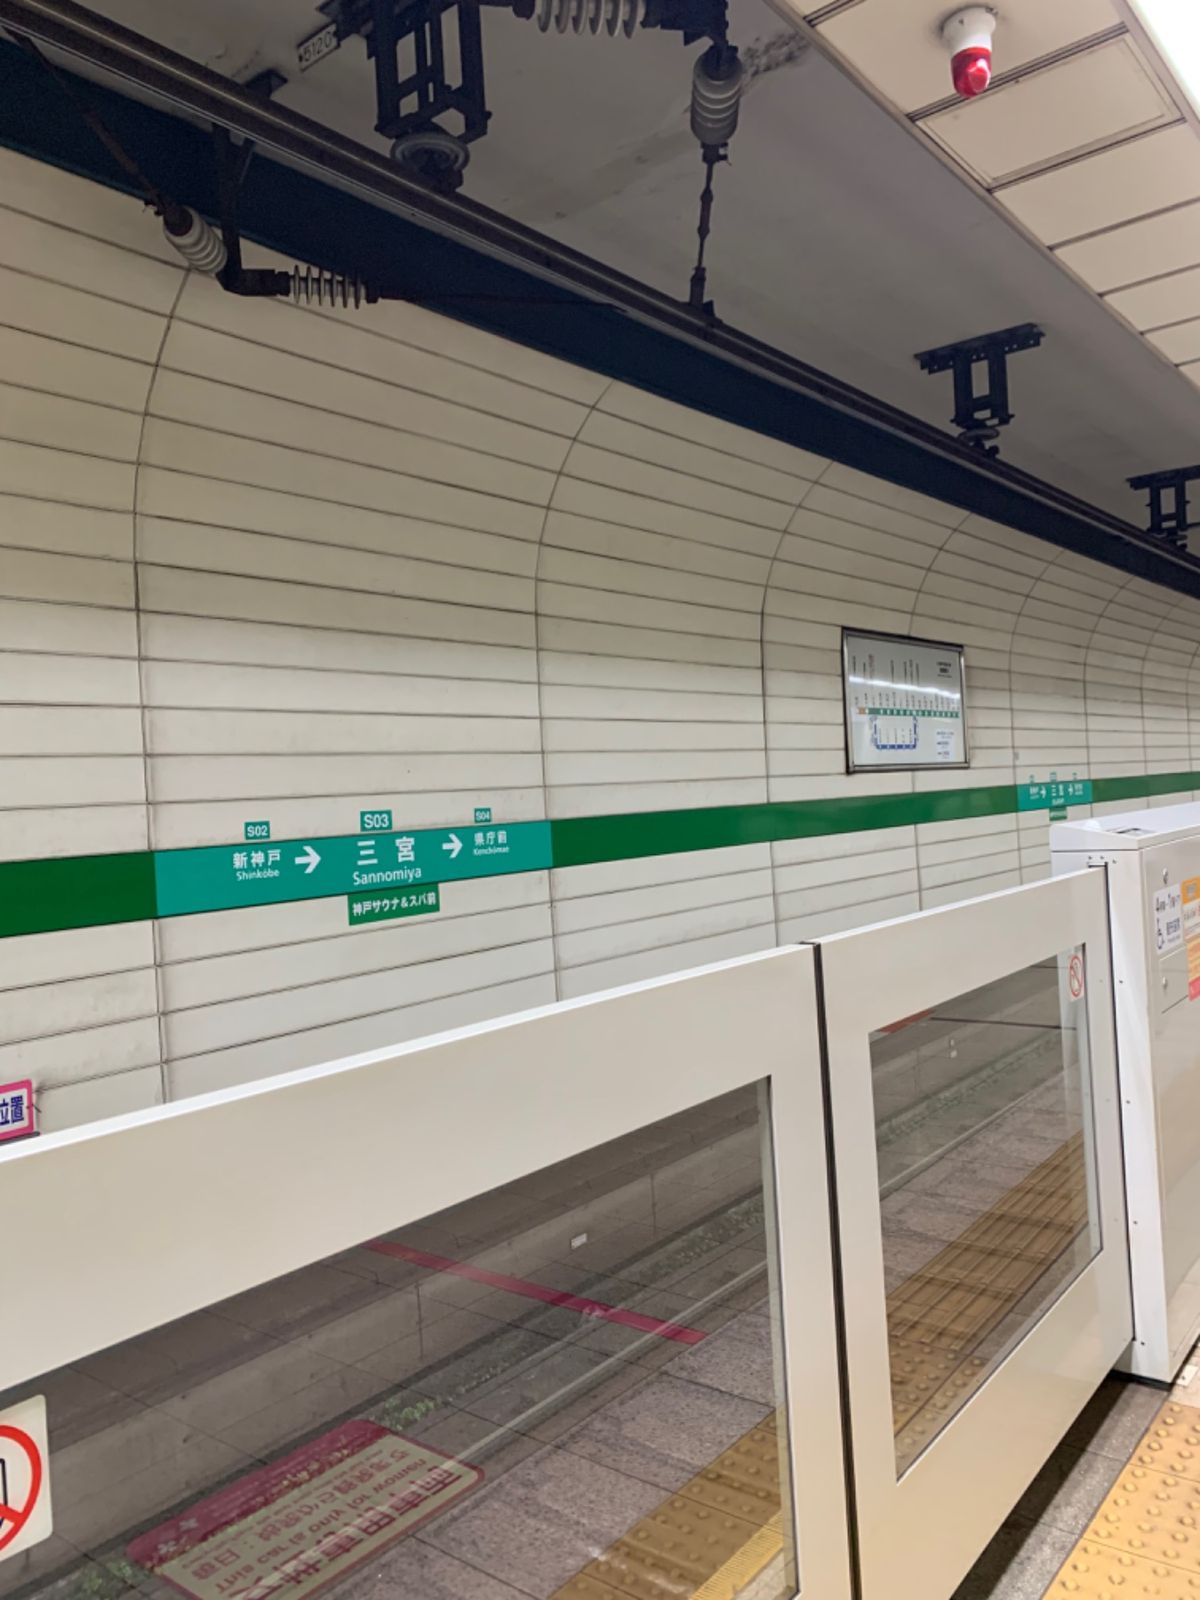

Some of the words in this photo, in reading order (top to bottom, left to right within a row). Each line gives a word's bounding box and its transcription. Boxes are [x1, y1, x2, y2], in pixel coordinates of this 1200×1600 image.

[303, 31, 332, 62] 5120
[363, 813, 390, 829] S03
[475, 810, 490, 822] S04
[246, 824, 268, 837] S02
[474, 829, 508, 847] 県庁前
[232, 849, 281, 869] 新神戸
[357, 836, 415, 866] 三宮
[352, 866, 422, 886] Sannomiya
